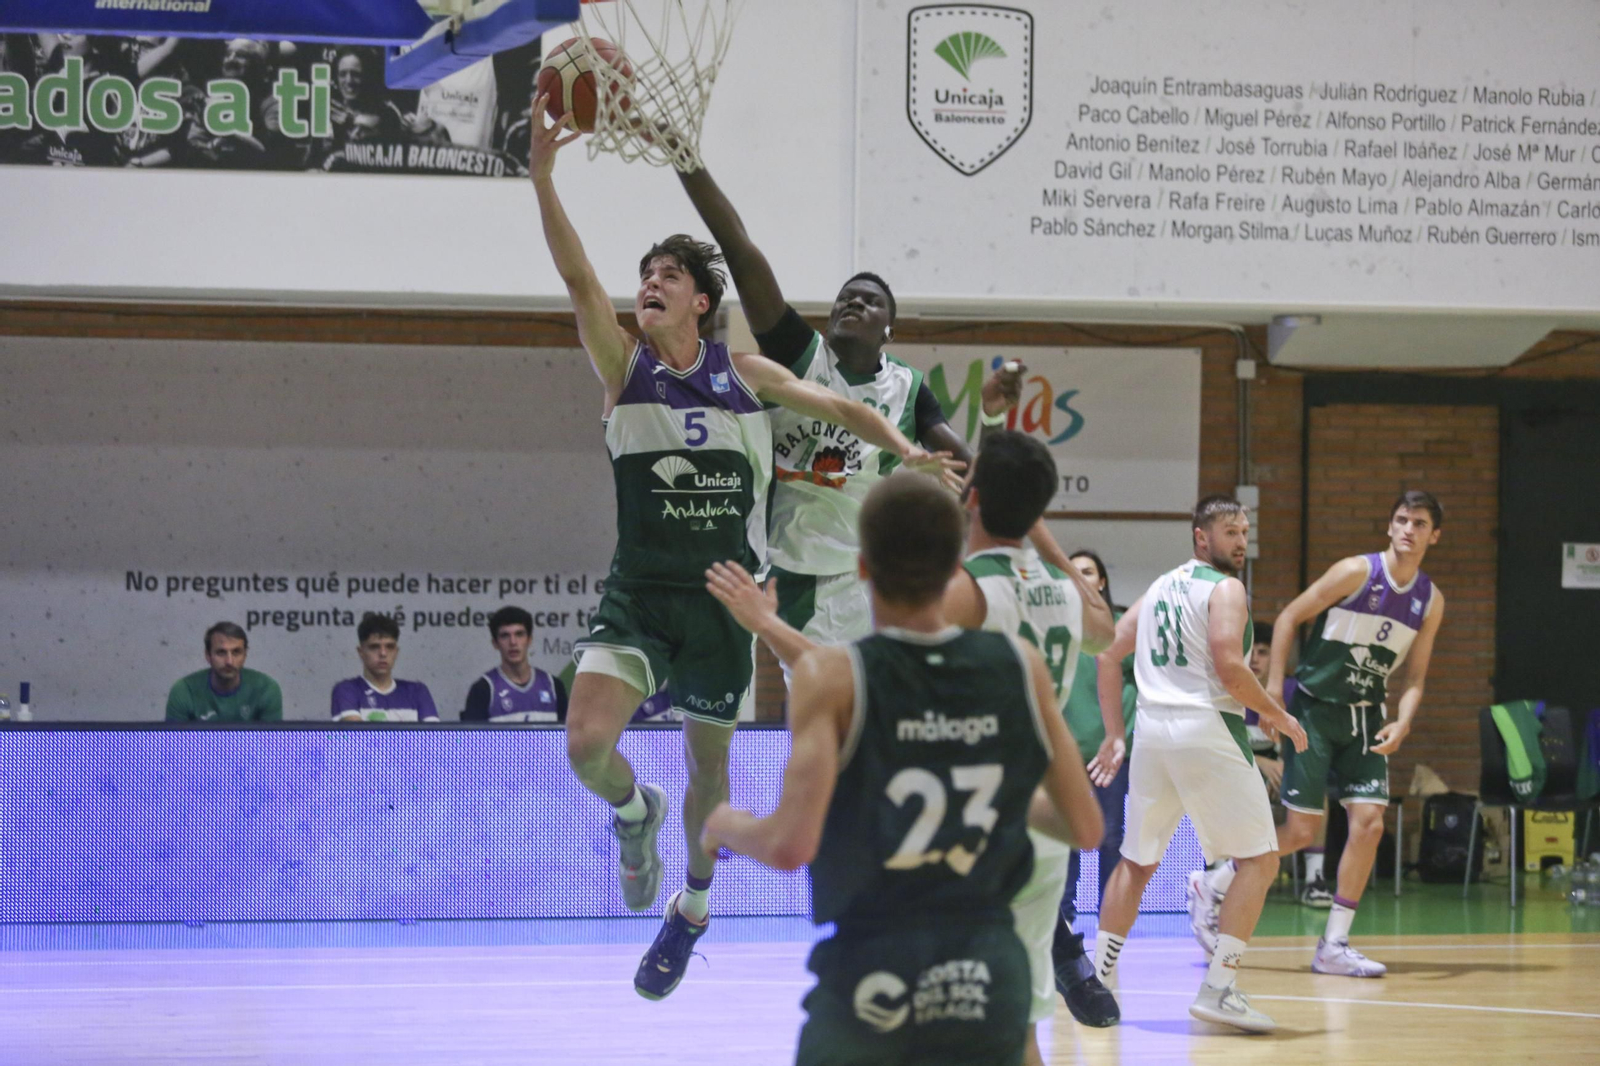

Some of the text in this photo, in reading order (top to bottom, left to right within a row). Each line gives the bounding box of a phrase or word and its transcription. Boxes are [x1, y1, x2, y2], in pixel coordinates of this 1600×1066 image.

[204, 79, 253, 137] a
[273, 64, 331, 138] ti
[934, 87, 1005, 109] Unicaja
[1090, 75, 1157, 98] Joaquín
[1163, 76, 1303, 102] Entrambasaguas
[1319, 81, 1367, 101] Julián
[1373, 83, 1457, 106] Rodríguez
[1473, 85, 1532, 106] Manolo
[1538, 87, 1585, 107] Rubia
[934, 113, 1005, 125] Baloncesto
[1078, 103, 1121, 124] Paco
[1126, 104, 1189, 126] Cabello
[1205, 107, 1258, 130] Miguel
[1264, 107, 1311, 129] Pérez
[1325, 111, 1386, 131] Alfonso
[1391, 112, 1446, 132] Portillo
[1461, 114, 1515, 134] Patrick
[1521, 115, 1600, 136] Fernánde
[345, 143, 505, 177] UNICAJA BALONCESTO
[1066, 132, 1130, 152] Antonio
[1137, 133, 1200, 154] Benítez
[1216, 136, 1255, 156] José
[1261, 137, 1328, 158] Torrubia
[1344, 139, 1397, 159] Rafael
[1403, 140, 1457, 160] Ibáñez
[1473, 143, 1511, 162] José
[1545, 144, 1575, 163] Mur
[1054, 160, 1103, 180] David
[1109, 161, 1132, 180] Gil
[1149, 163, 1210, 183] Manolo
[1216, 163, 1265, 184] Pérez
[1281, 165, 1336, 187] Rubén
[1342, 168, 1387, 188] Mayo
[1402, 169, 1480, 192] Alejandro
[1484, 170, 1520, 190] Alba
[1042, 188, 1077, 208] Miki
[1083, 189, 1151, 209] Servera
[1169, 191, 1209, 211] Rafa
[1215, 191, 1265, 212] Freire
[1281, 193, 1351, 218] Augusto
[1357, 196, 1398, 215] Lima
[1414, 197, 1463, 217] Pablo
[1467, 198, 1540, 218] Almazán
[1030, 216, 1078, 236] Pablo
[1083, 217, 1156, 239] Sánchez
[1171, 220, 1234, 244] Morgan
[1238, 220, 1289, 241] Stilma
[1304, 223, 1353, 242] Lucas
[1358, 224, 1412, 244] Muñoz
[1427, 225, 1480, 245] Rubén
[1485, 226, 1556, 246] Guerrero
[928, 355, 1085, 445] Mas
[684, 412, 708, 447] 5
[662, 498, 741, 520] Andalucía
[125, 570, 159, 592] No
[166, 572, 288, 599] preguntes
[295, 571, 340, 599] qué
[347, 573, 420, 599] puede
[427, 573, 492, 595] hacer
[499, 576, 538, 599] por
[543, 573, 560, 595] ti
[566, 574, 586, 595] el
[246, 607, 355, 632] pregunta
[1151, 600, 1189, 667] 31
[1376, 621, 1392, 642] 8
[884, 764, 1003, 876] 23
